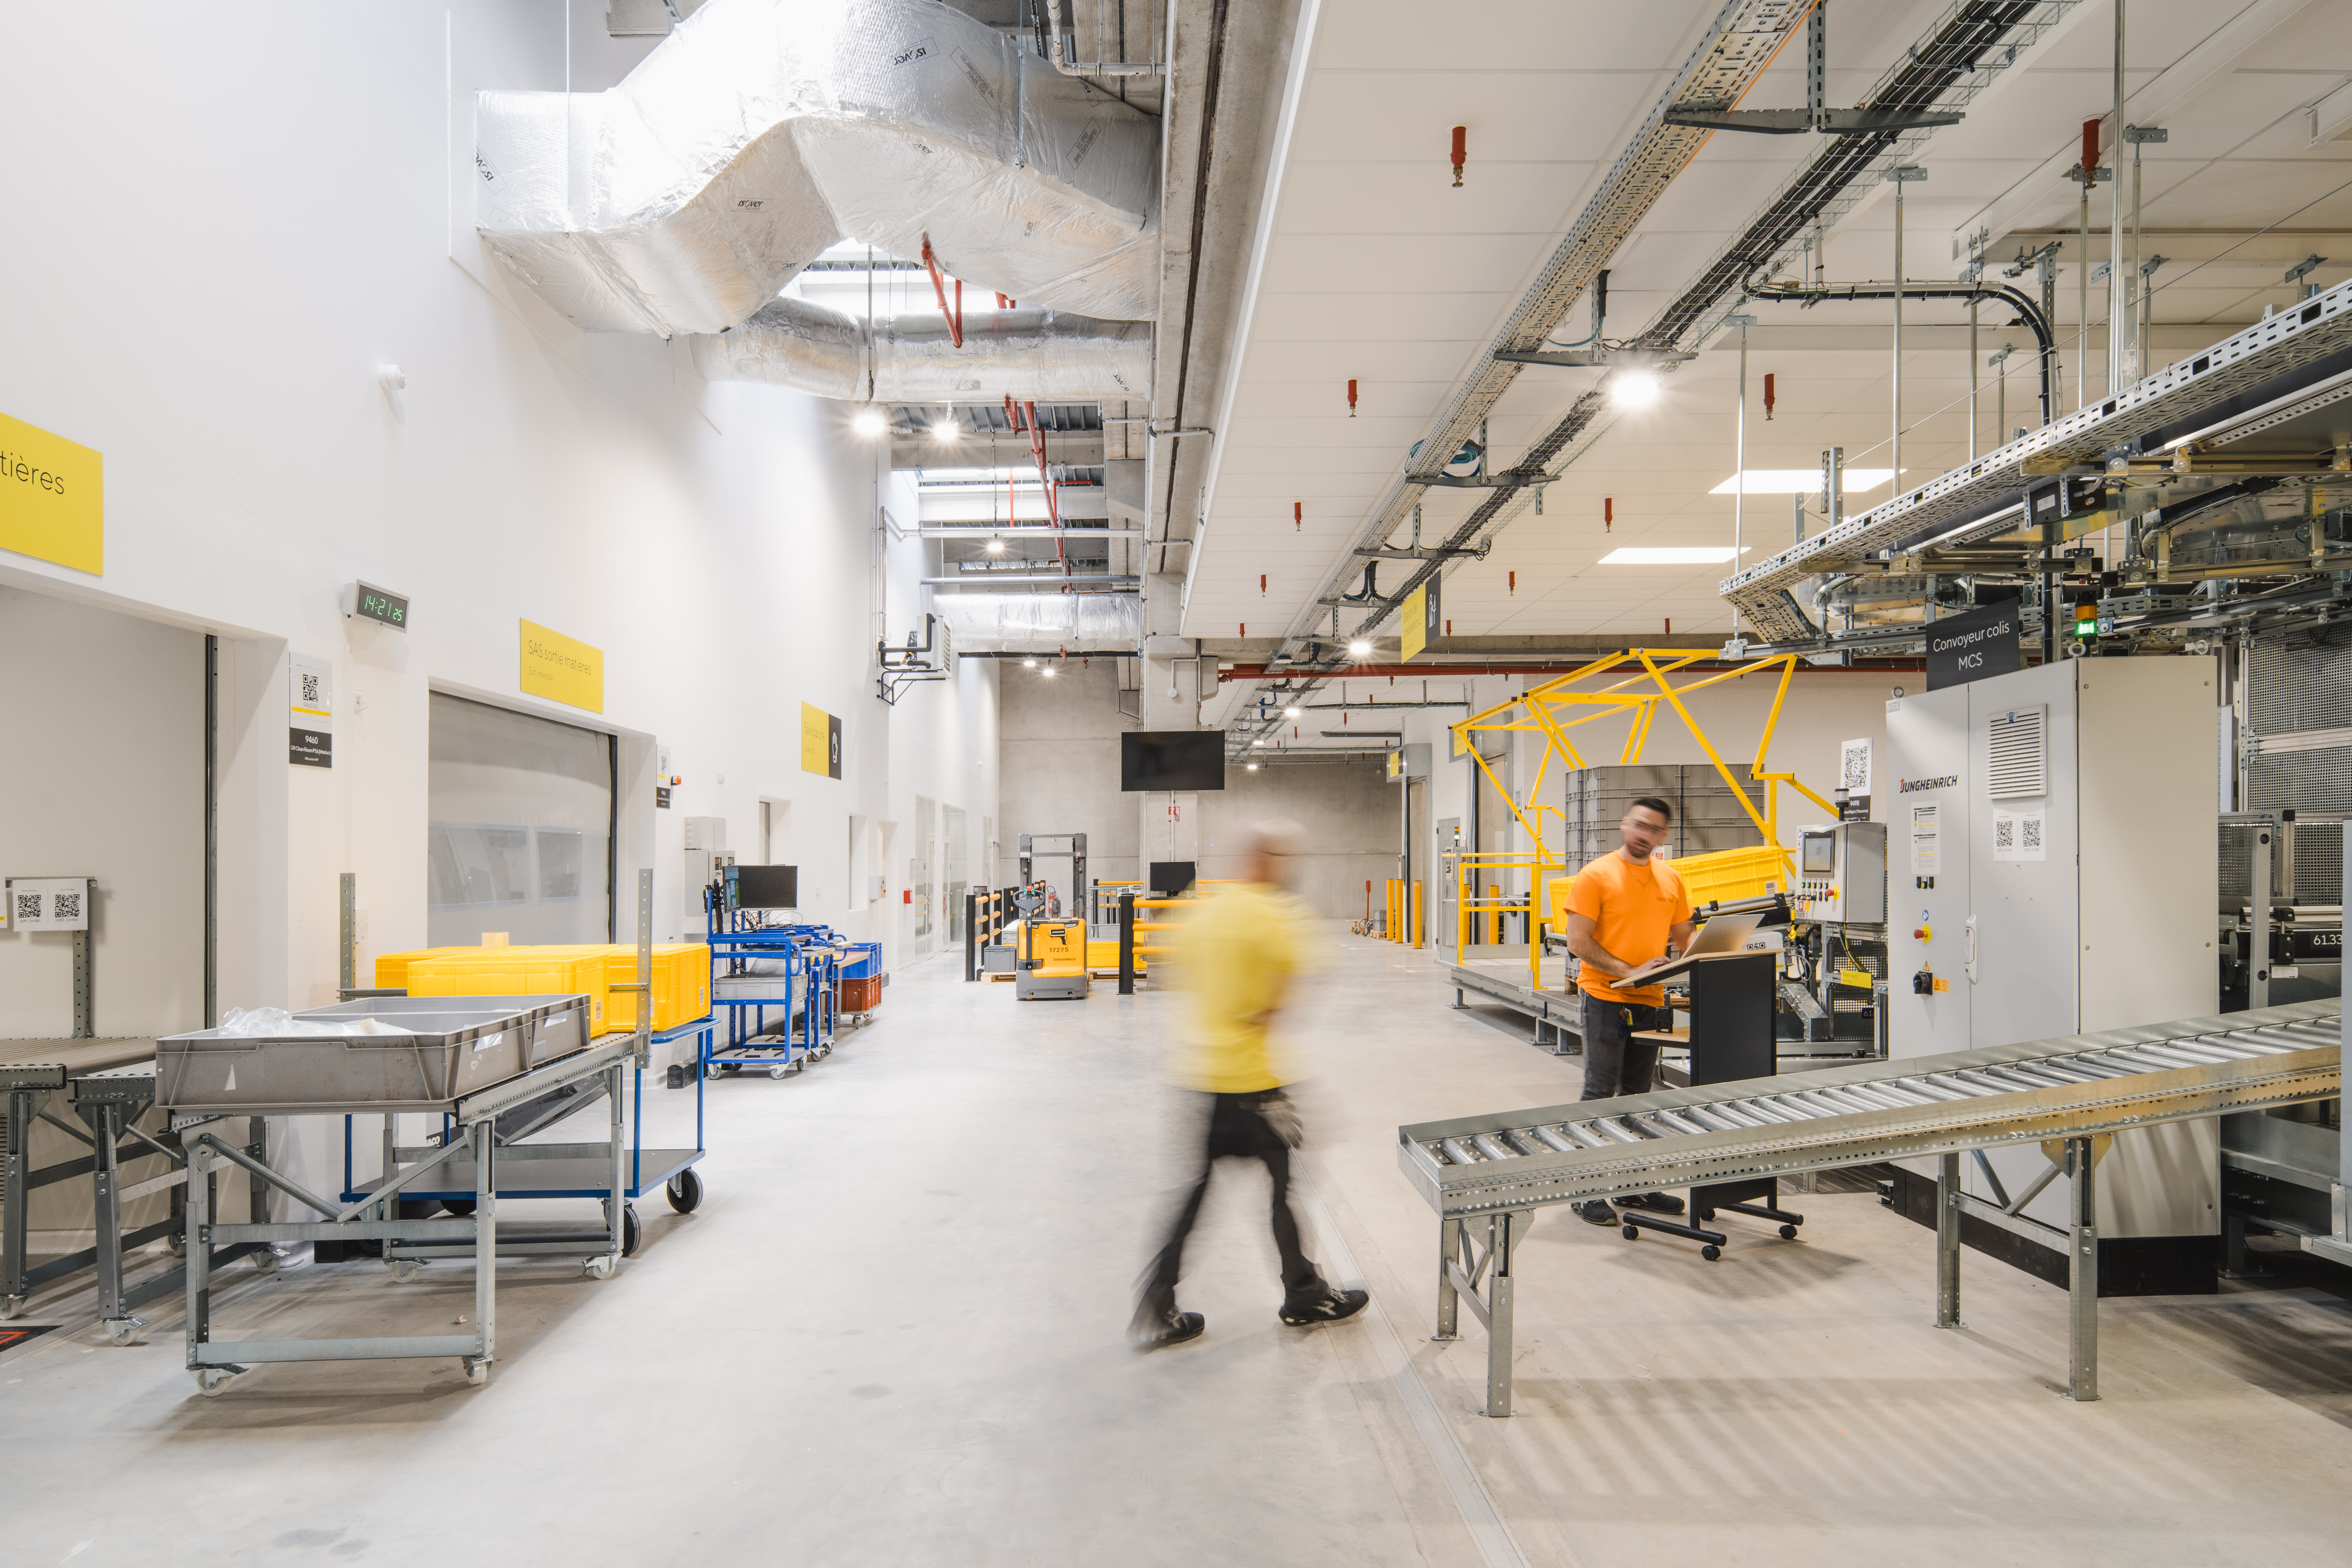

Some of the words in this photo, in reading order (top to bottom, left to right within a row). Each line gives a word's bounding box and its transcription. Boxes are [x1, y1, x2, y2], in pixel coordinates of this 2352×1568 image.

[365, 595, 392, 617] 14:21
[392, 608, 403, 621] 25
[1933, 629, 1985, 652] Convoyeur
[1986, 621, 2010, 638] colis
[529, 640, 543, 658] SAS
[545, 649, 563, 665] sortie
[564, 656, 591, 675] matières
[1959, 652, 1983, 671] MCS
[537, 669, 554, 682] interlock
[305, 735, 318, 744] 9460
[812, 725, 825, 741] blanche
[1900, 775, 1958, 794] JUNGHEINRICH
[2313, 934, 2342, 945] 61.33
